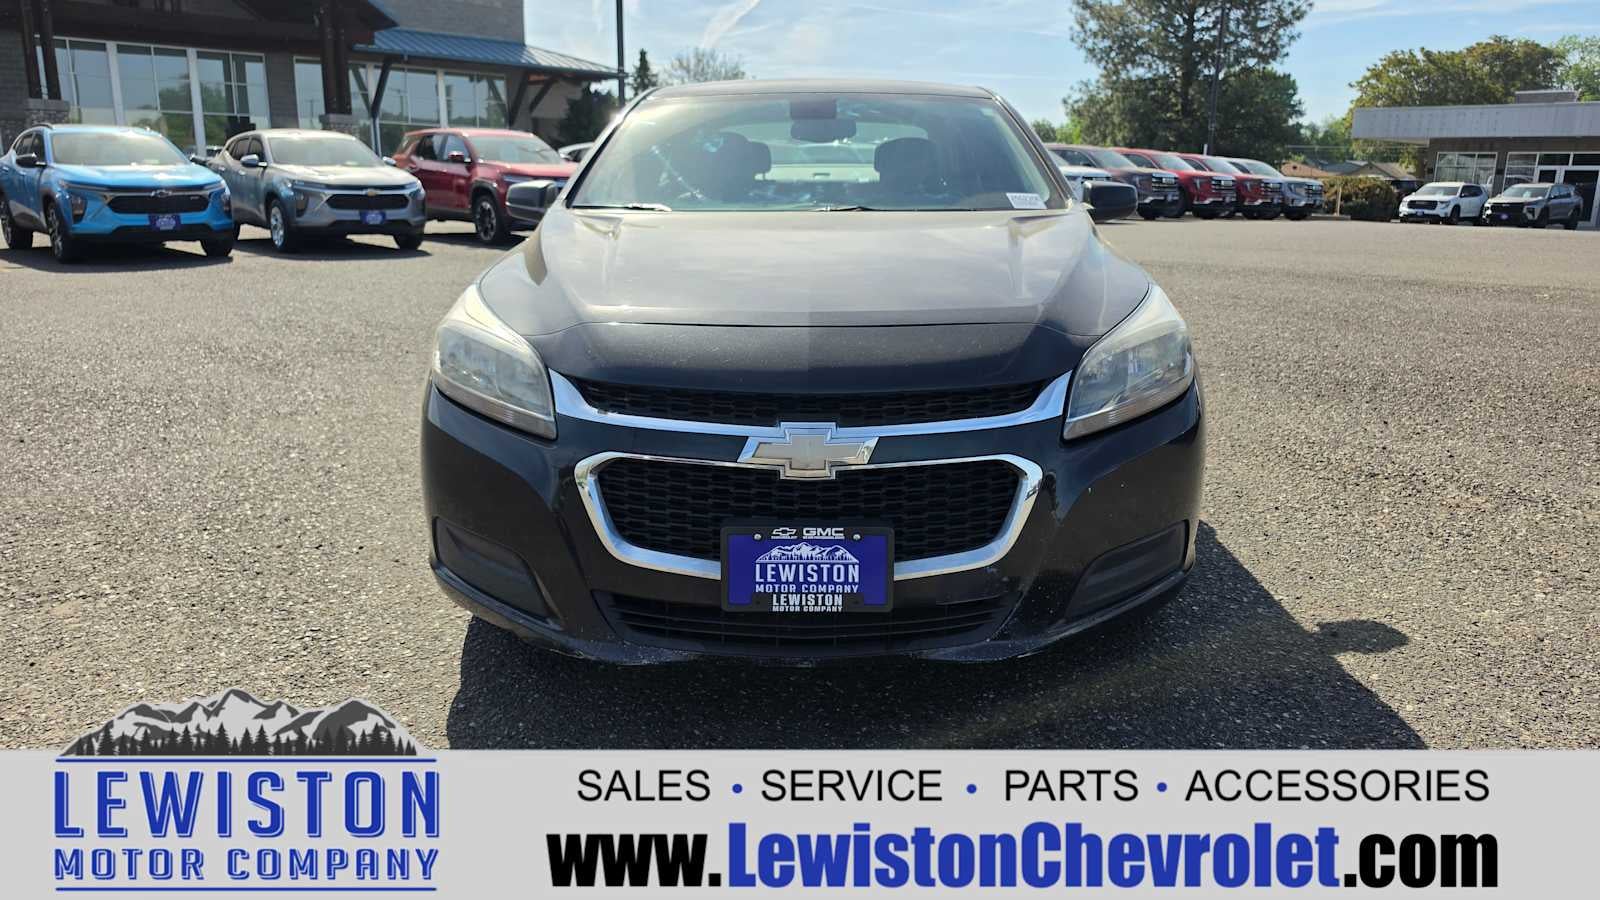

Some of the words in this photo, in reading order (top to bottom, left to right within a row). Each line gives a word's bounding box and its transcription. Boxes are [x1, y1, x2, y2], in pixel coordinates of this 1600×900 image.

[803, 528, 844, 536] GMC
[755, 564, 860, 583] LEWISTON
[755, 584, 797, 593] MOTOR
[802, 584, 859, 593] COMPANY
[772, 594, 843, 606] LEWISTON
